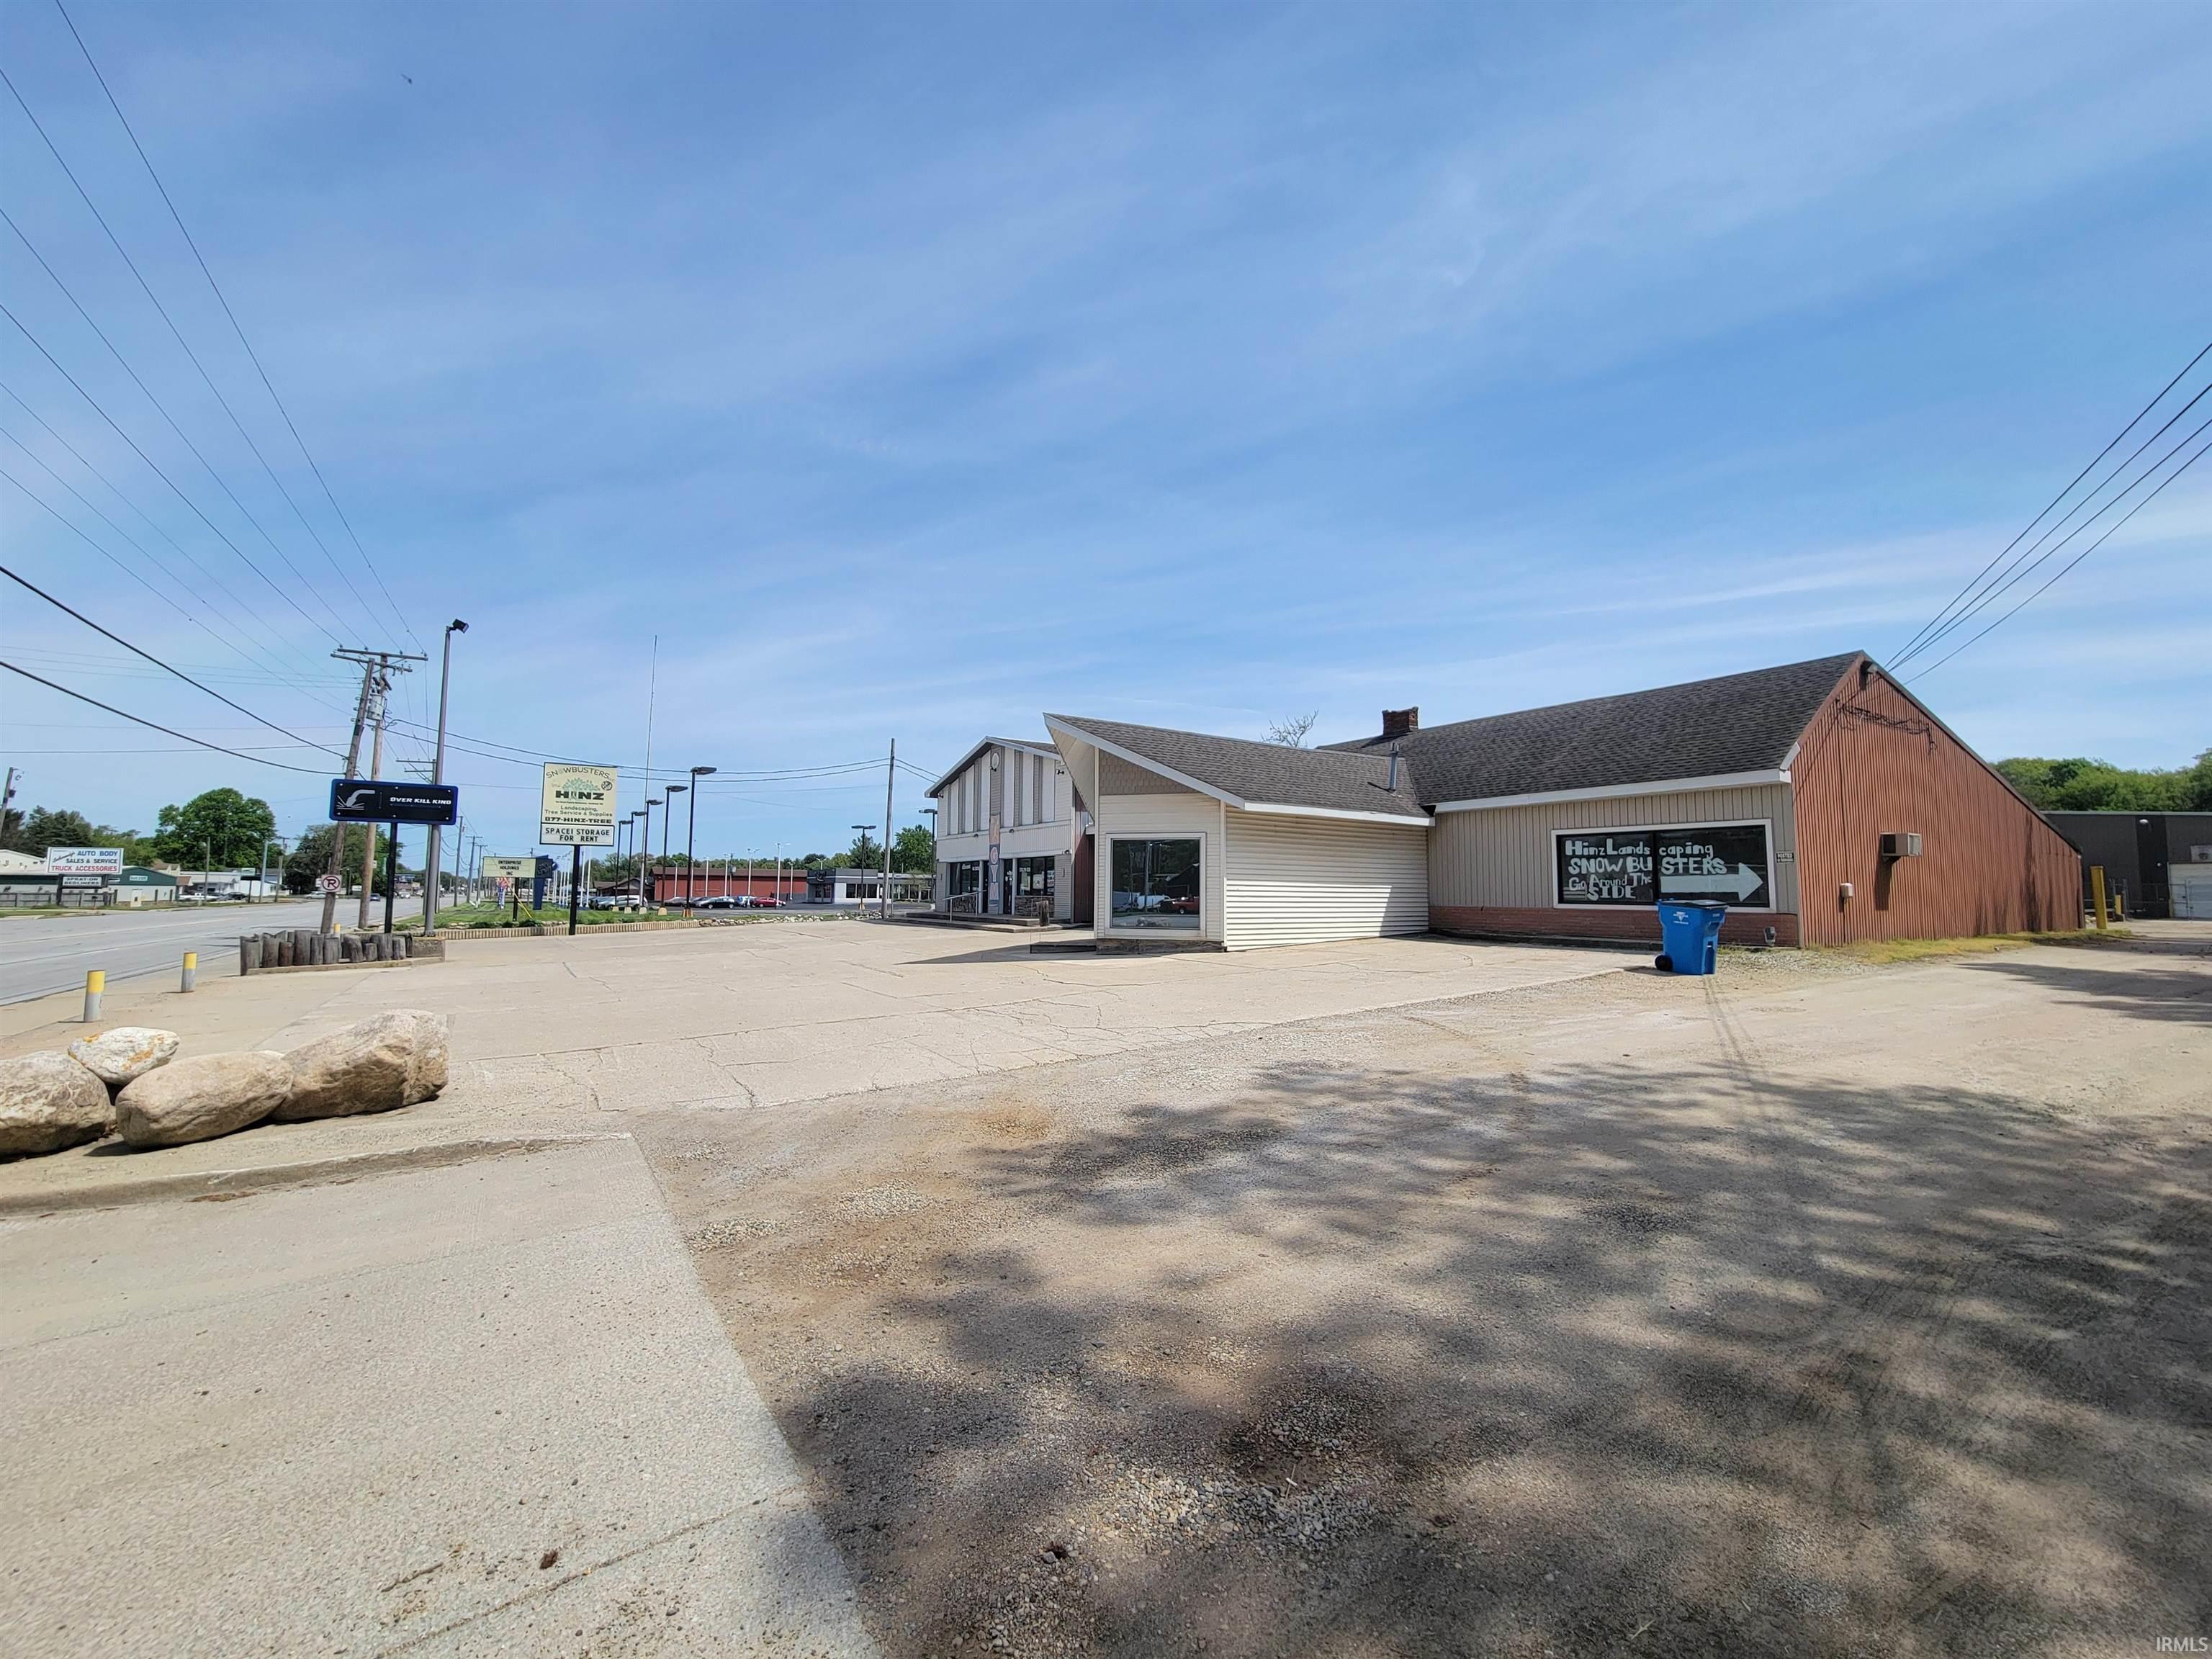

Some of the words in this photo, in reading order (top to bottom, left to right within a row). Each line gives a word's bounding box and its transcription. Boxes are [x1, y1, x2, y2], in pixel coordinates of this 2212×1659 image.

[555, 791, 604, 800] HINZ
[990, 847, 999, 899] GYM
[1568, 877, 1586, 891] Go
[1588, 874, 1627, 888] Around
[1587, 886, 1636, 901] SIDE
